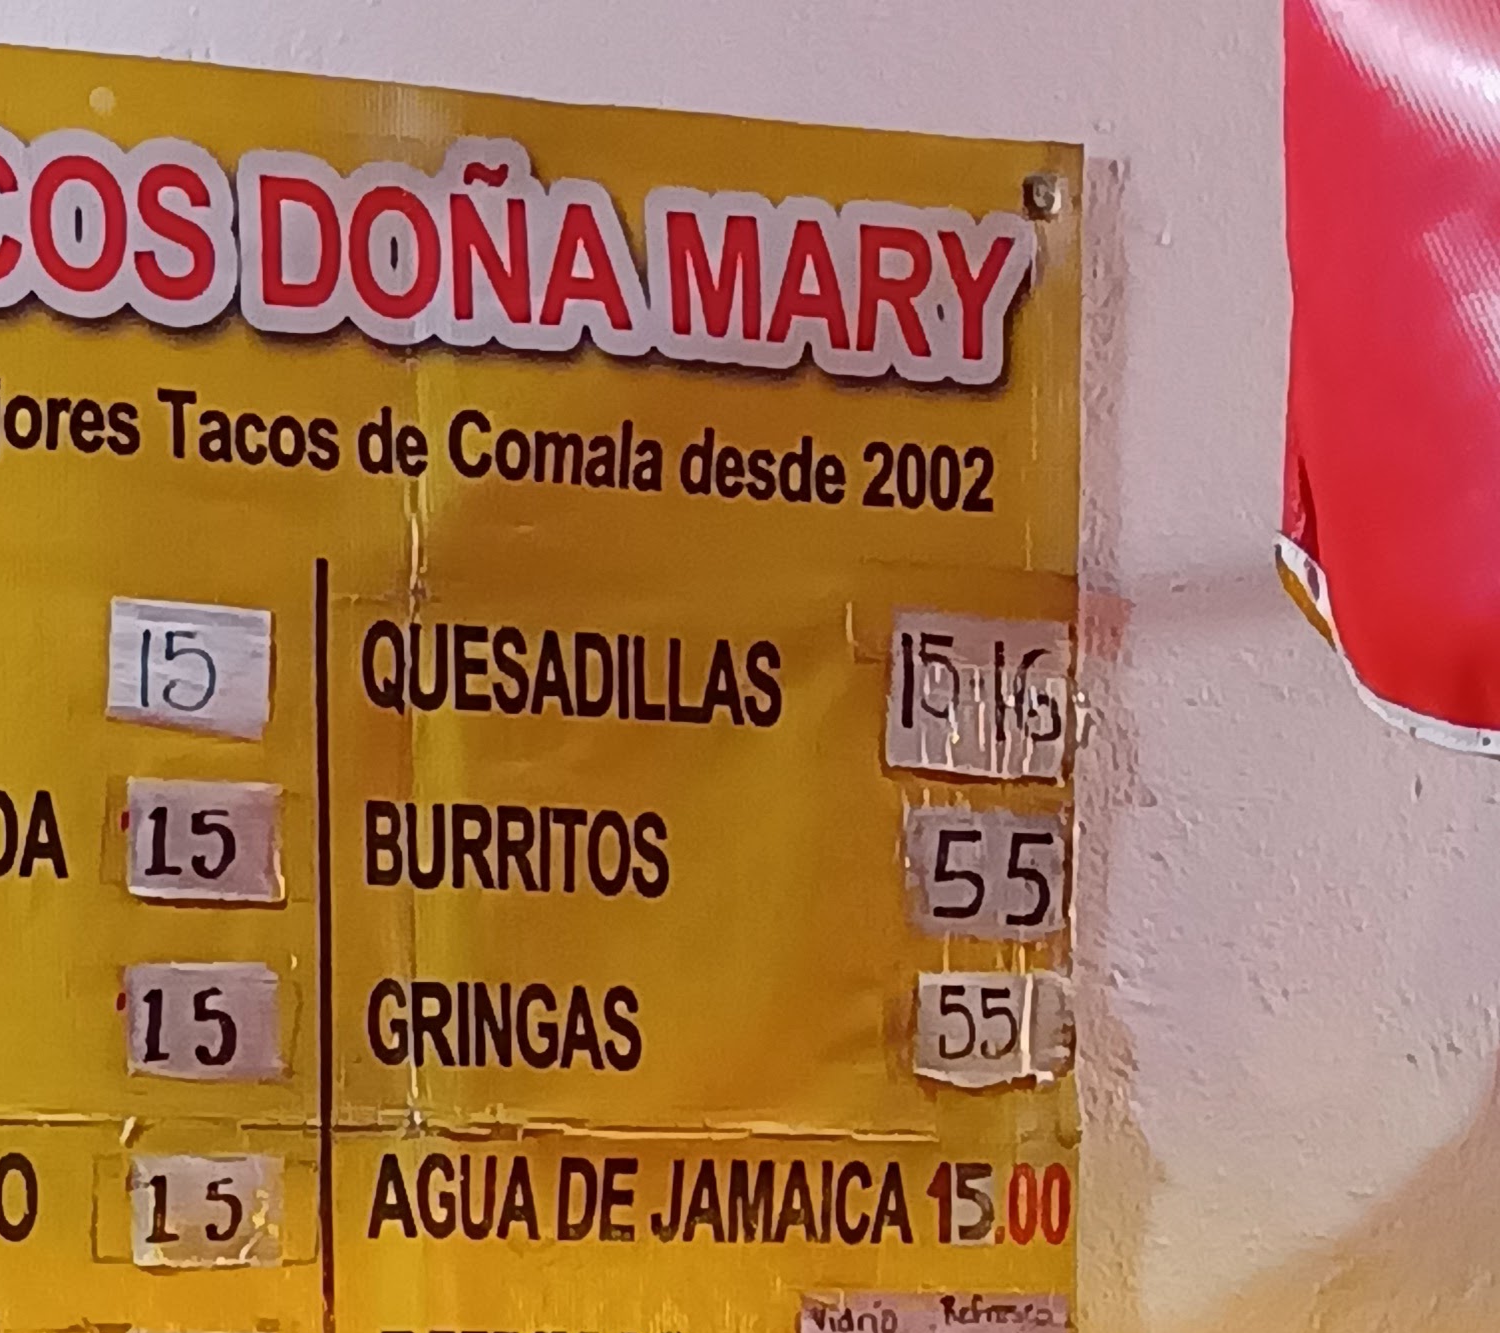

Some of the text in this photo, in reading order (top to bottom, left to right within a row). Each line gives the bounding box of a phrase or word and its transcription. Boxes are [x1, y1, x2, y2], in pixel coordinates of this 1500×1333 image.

[257, 160, 634, 332] DOÑA
[663, 210, 1017, 361] MARY
[156, 387, 341, 472] Tacos
[357, 405, 429, 477] de
[447, 409, 663, 492] Comala
[679, 427, 847, 504] desde
[862, 440, 995, 513] 2002
[139, 628, 218, 712] 15
[361, 618, 782, 728] QUESADILLAS
[143, 805, 237, 880] 15
[365, 800, 670, 899] BURRITOS
[932, 829, 1054, 926] 55
[141, 987, 238, 1066] 15
[367, 977, 643, 1072] GRINGAS
[939, 985, 1018, 1060] 55
[144, 1174, 243, 1243] 15
[367, 1152, 1072, 1246] AGUA DE JAMAICA 15.00
